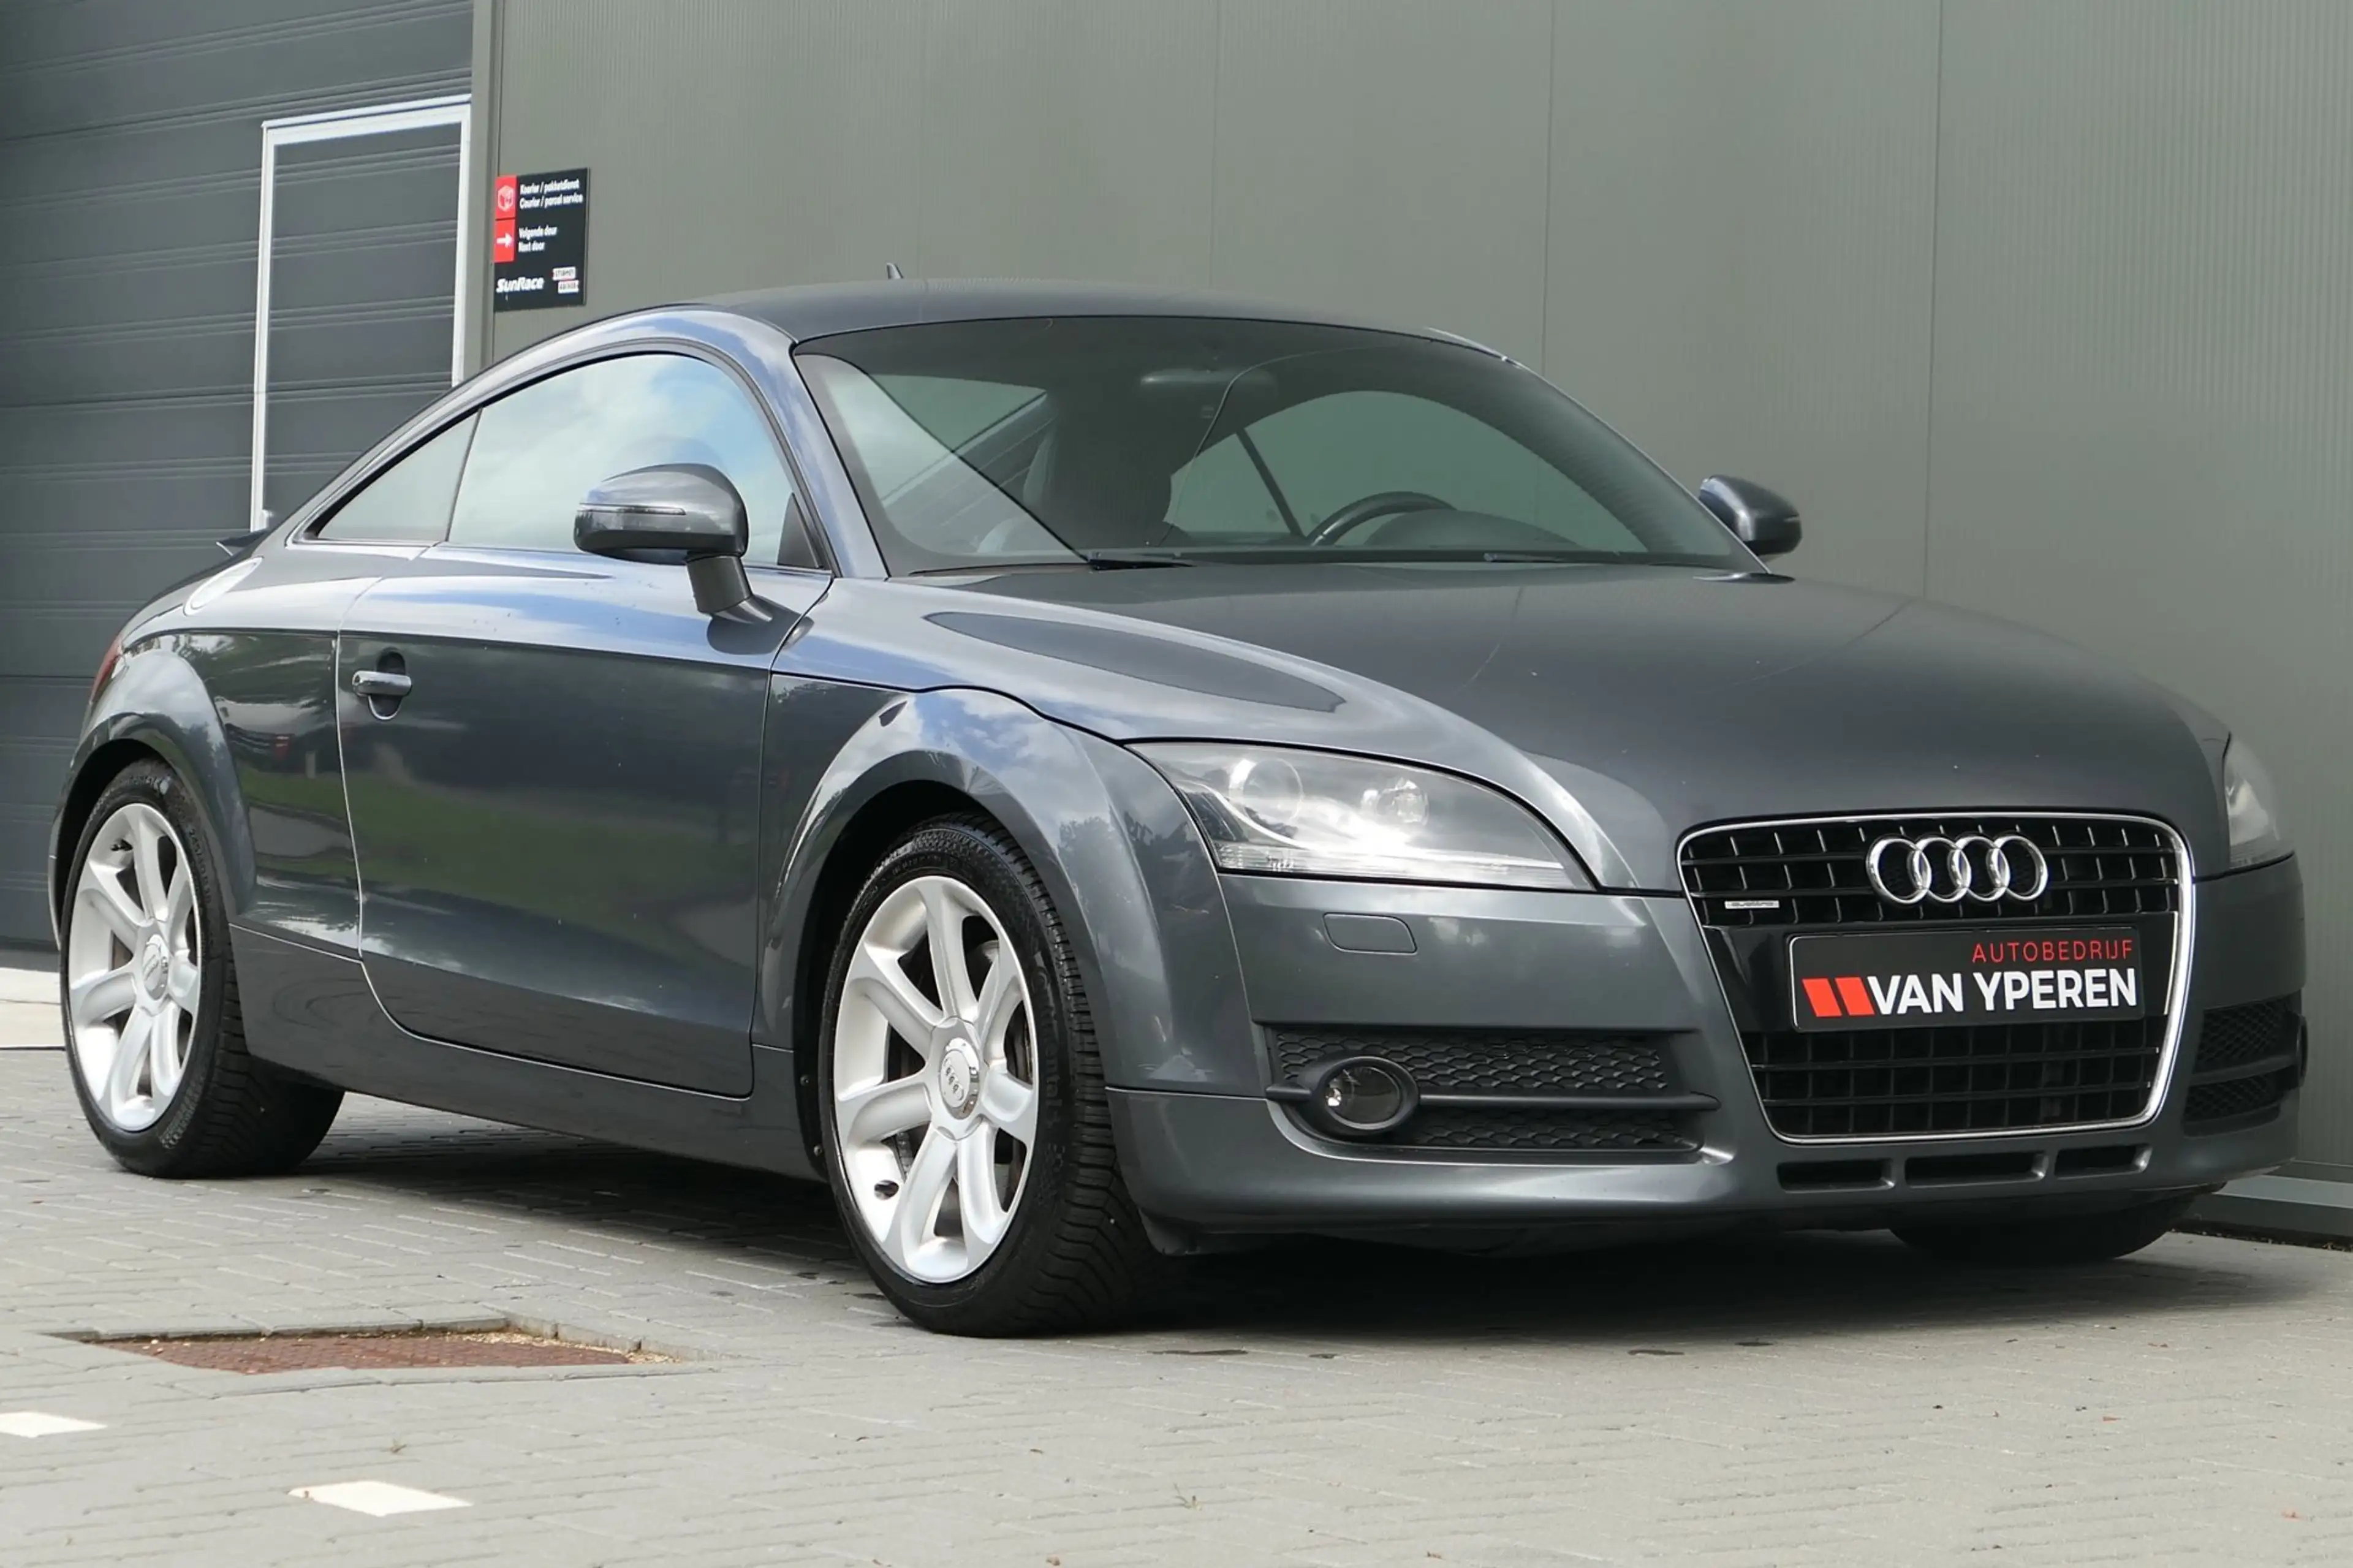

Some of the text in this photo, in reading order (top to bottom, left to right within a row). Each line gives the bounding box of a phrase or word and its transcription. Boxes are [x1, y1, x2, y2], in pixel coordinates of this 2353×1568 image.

[520, 197, 540, 209] Courier
[563, 192, 583, 204] service
[532, 240, 545, 251] door
[496, 277, 544, 293] SunRace
[1972, 939, 2132, 963] AUTOBEDRIJF
[1866, 968, 2137, 1015] VAN YPEREN
